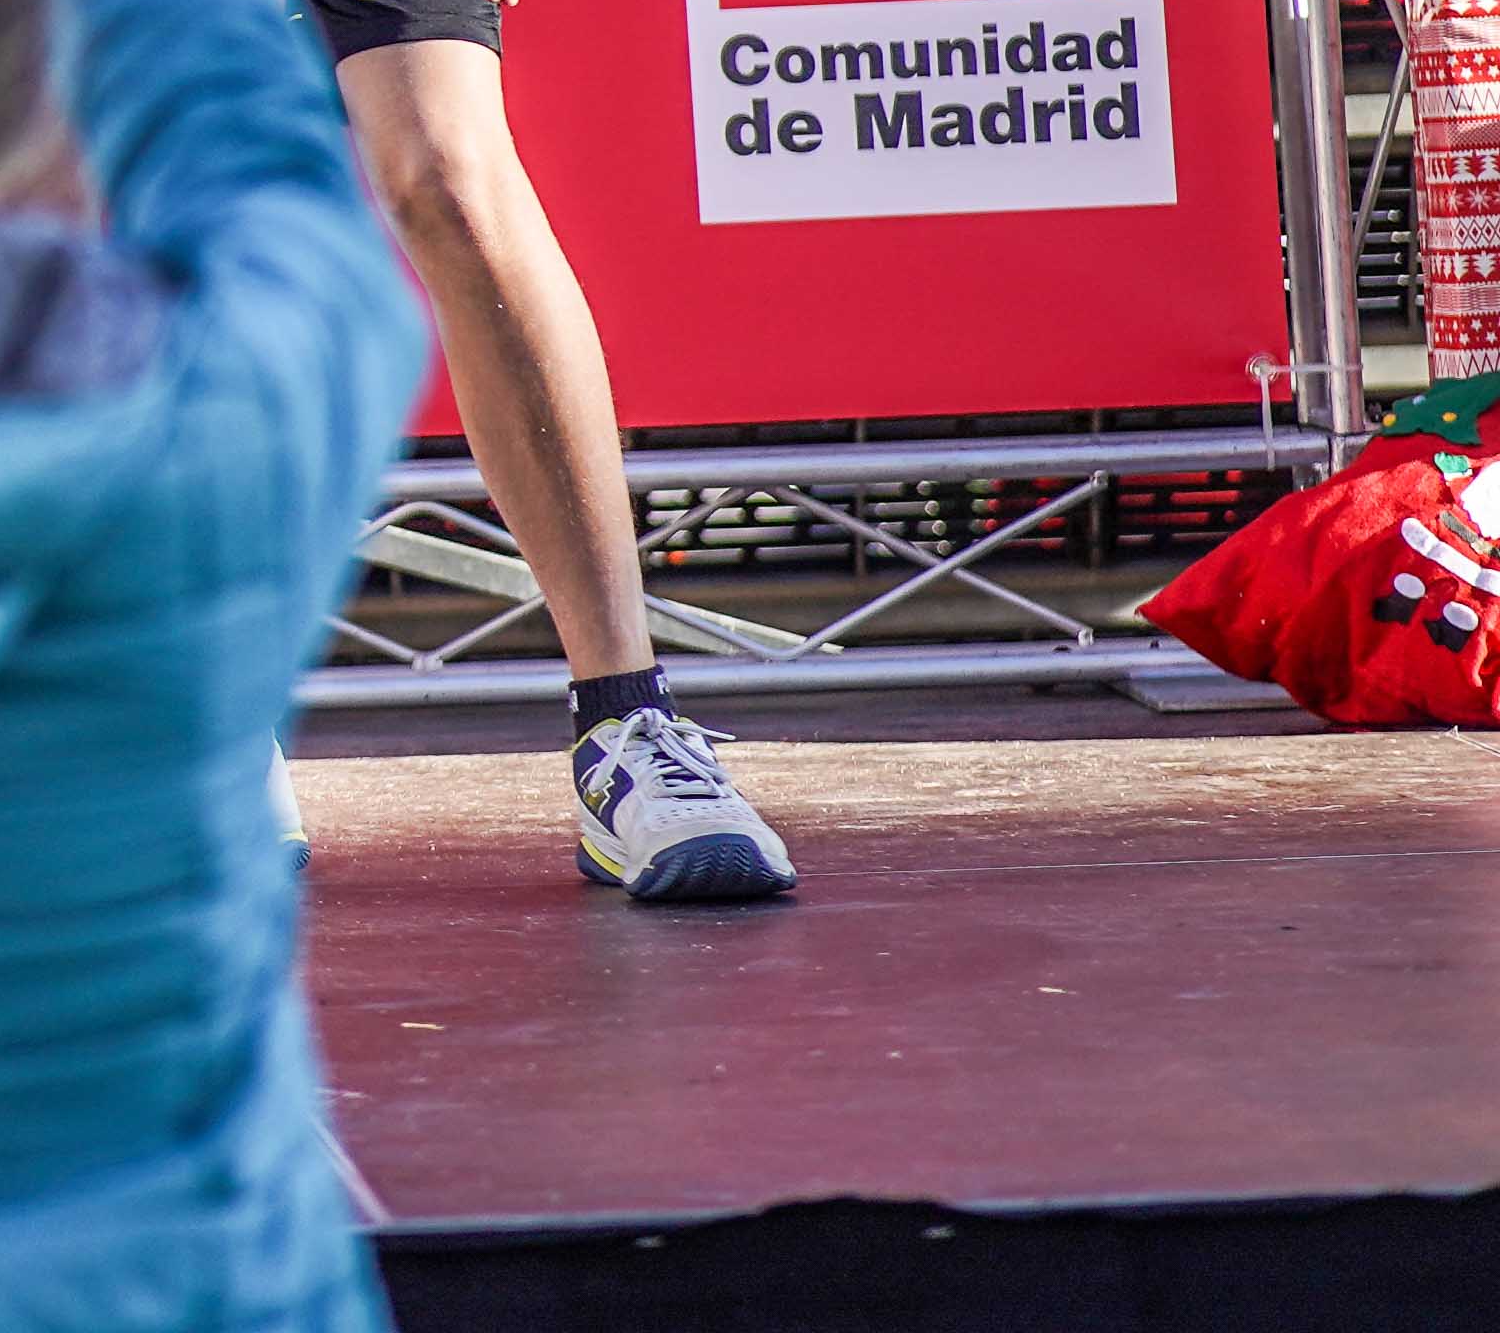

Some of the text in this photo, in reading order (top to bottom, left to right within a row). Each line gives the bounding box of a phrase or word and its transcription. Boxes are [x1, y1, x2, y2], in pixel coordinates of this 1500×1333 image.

[720, 17, 1138, 86] Comunidad
[725, 81, 1141, 156] de Madrid
